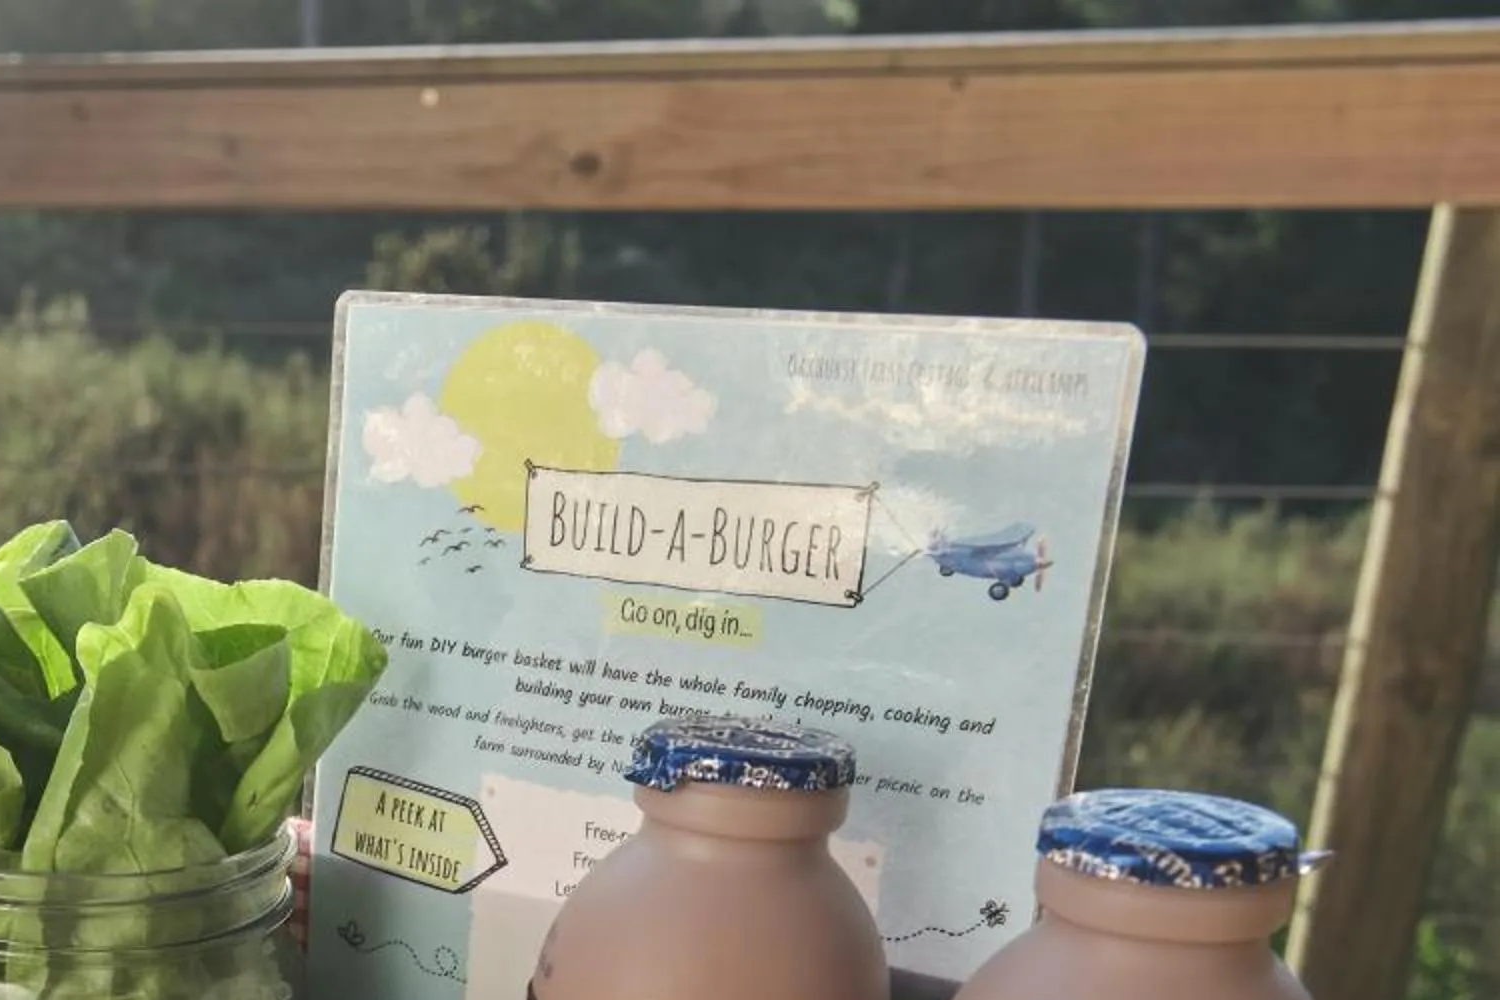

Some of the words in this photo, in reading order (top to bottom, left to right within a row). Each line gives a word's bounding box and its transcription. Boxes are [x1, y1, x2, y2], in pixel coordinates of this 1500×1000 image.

[549, 490, 842, 580] BUILD-A-BURGER
[621, 598, 648, 623] Go
[652, 611, 680, 633] on,
[685, 607, 715, 639] dig
[401, 631, 423, 650] fun
[430, 636, 457, 655] DIY
[462, 641, 507, 665] burger
[513, 650, 563, 671] basket
[569, 659, 596, 676] will
[602, 663, 638, 683] have
[646, 667, 672, 687] the
[679, 674, 726, 694] whole
[733, 681, 787, 708] family
[795, 693, 875, 722] chopping,
[884, 706, 950, 733] cooking
[959, 717, 996, 736] and
[515, 678, 573, 704] building
[579, 689, 613, 707] your
[620, 697, 651, 711] own
[403, 696, 423, 711] the
[428, 705, 462, 719] wood
[465, 709, 490, 724] and
[494, 707, 566, 739] firelighters,
[572, 729, 595, 745] get
[601, 729, 624, 745] the
[875, 777, 923, 794] picnic
[930, 787, 950, 799] on
[957, 788, 985, 805] the
[473, 735, 504, 753] farm
[510, 743, 581, 767] surrounded
[588, 756, 604, 775] by
[375, 792, 385, 816] A
[391, 796, 425, 829] PEEK
[429, 810, 446, 833] AT
[354, 831, 404, 867] WHAT'S
[408, 848, 461, 884] INSIDE
